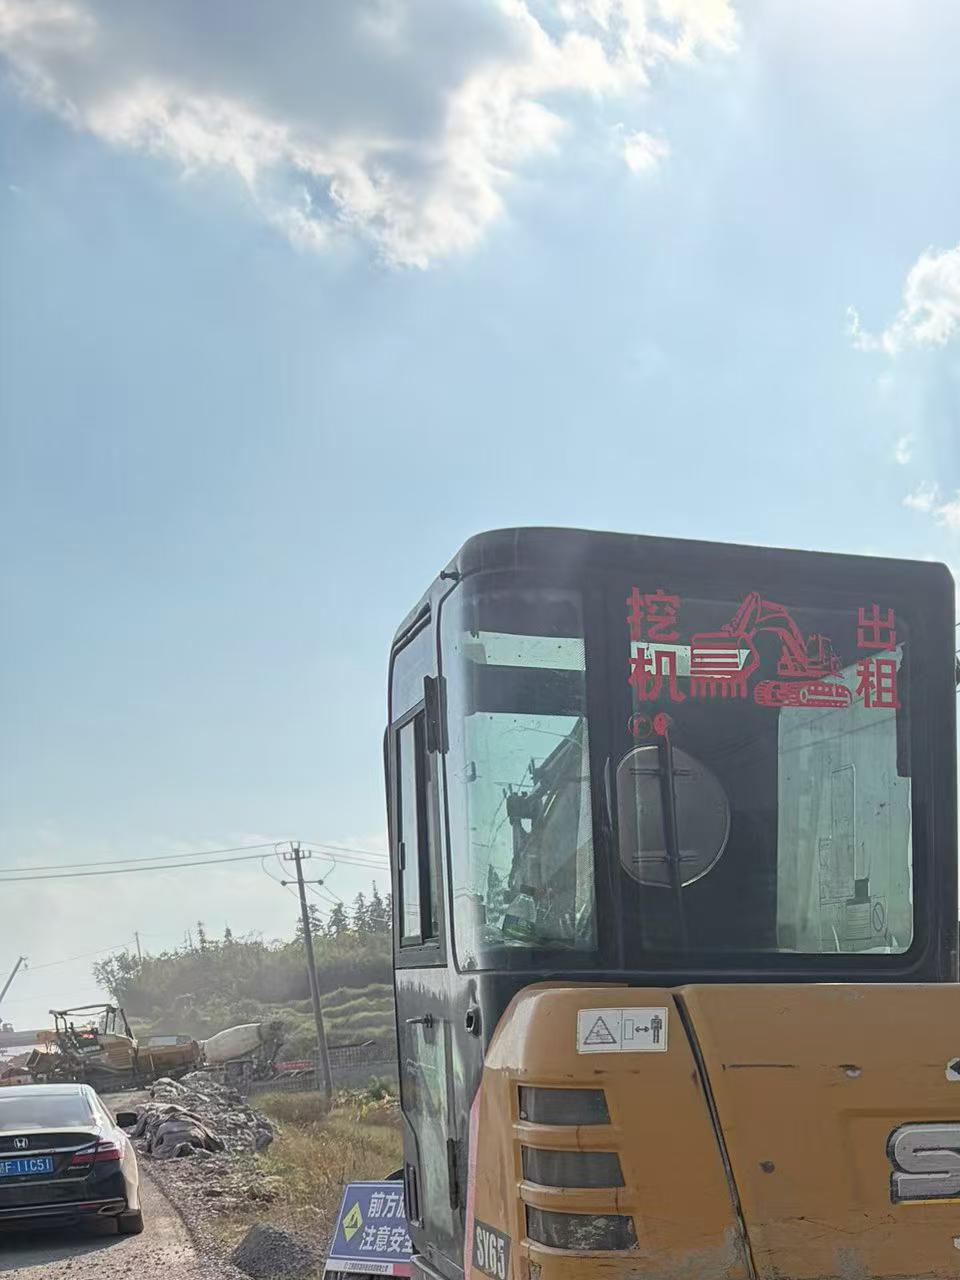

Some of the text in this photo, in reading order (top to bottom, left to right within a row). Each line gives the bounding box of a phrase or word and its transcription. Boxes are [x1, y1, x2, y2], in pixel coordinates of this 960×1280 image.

[626, 586, 686, 702] 挖机
[856, 602, 900, 709] 出租
[476, 1225, 506, 1280] SY65
